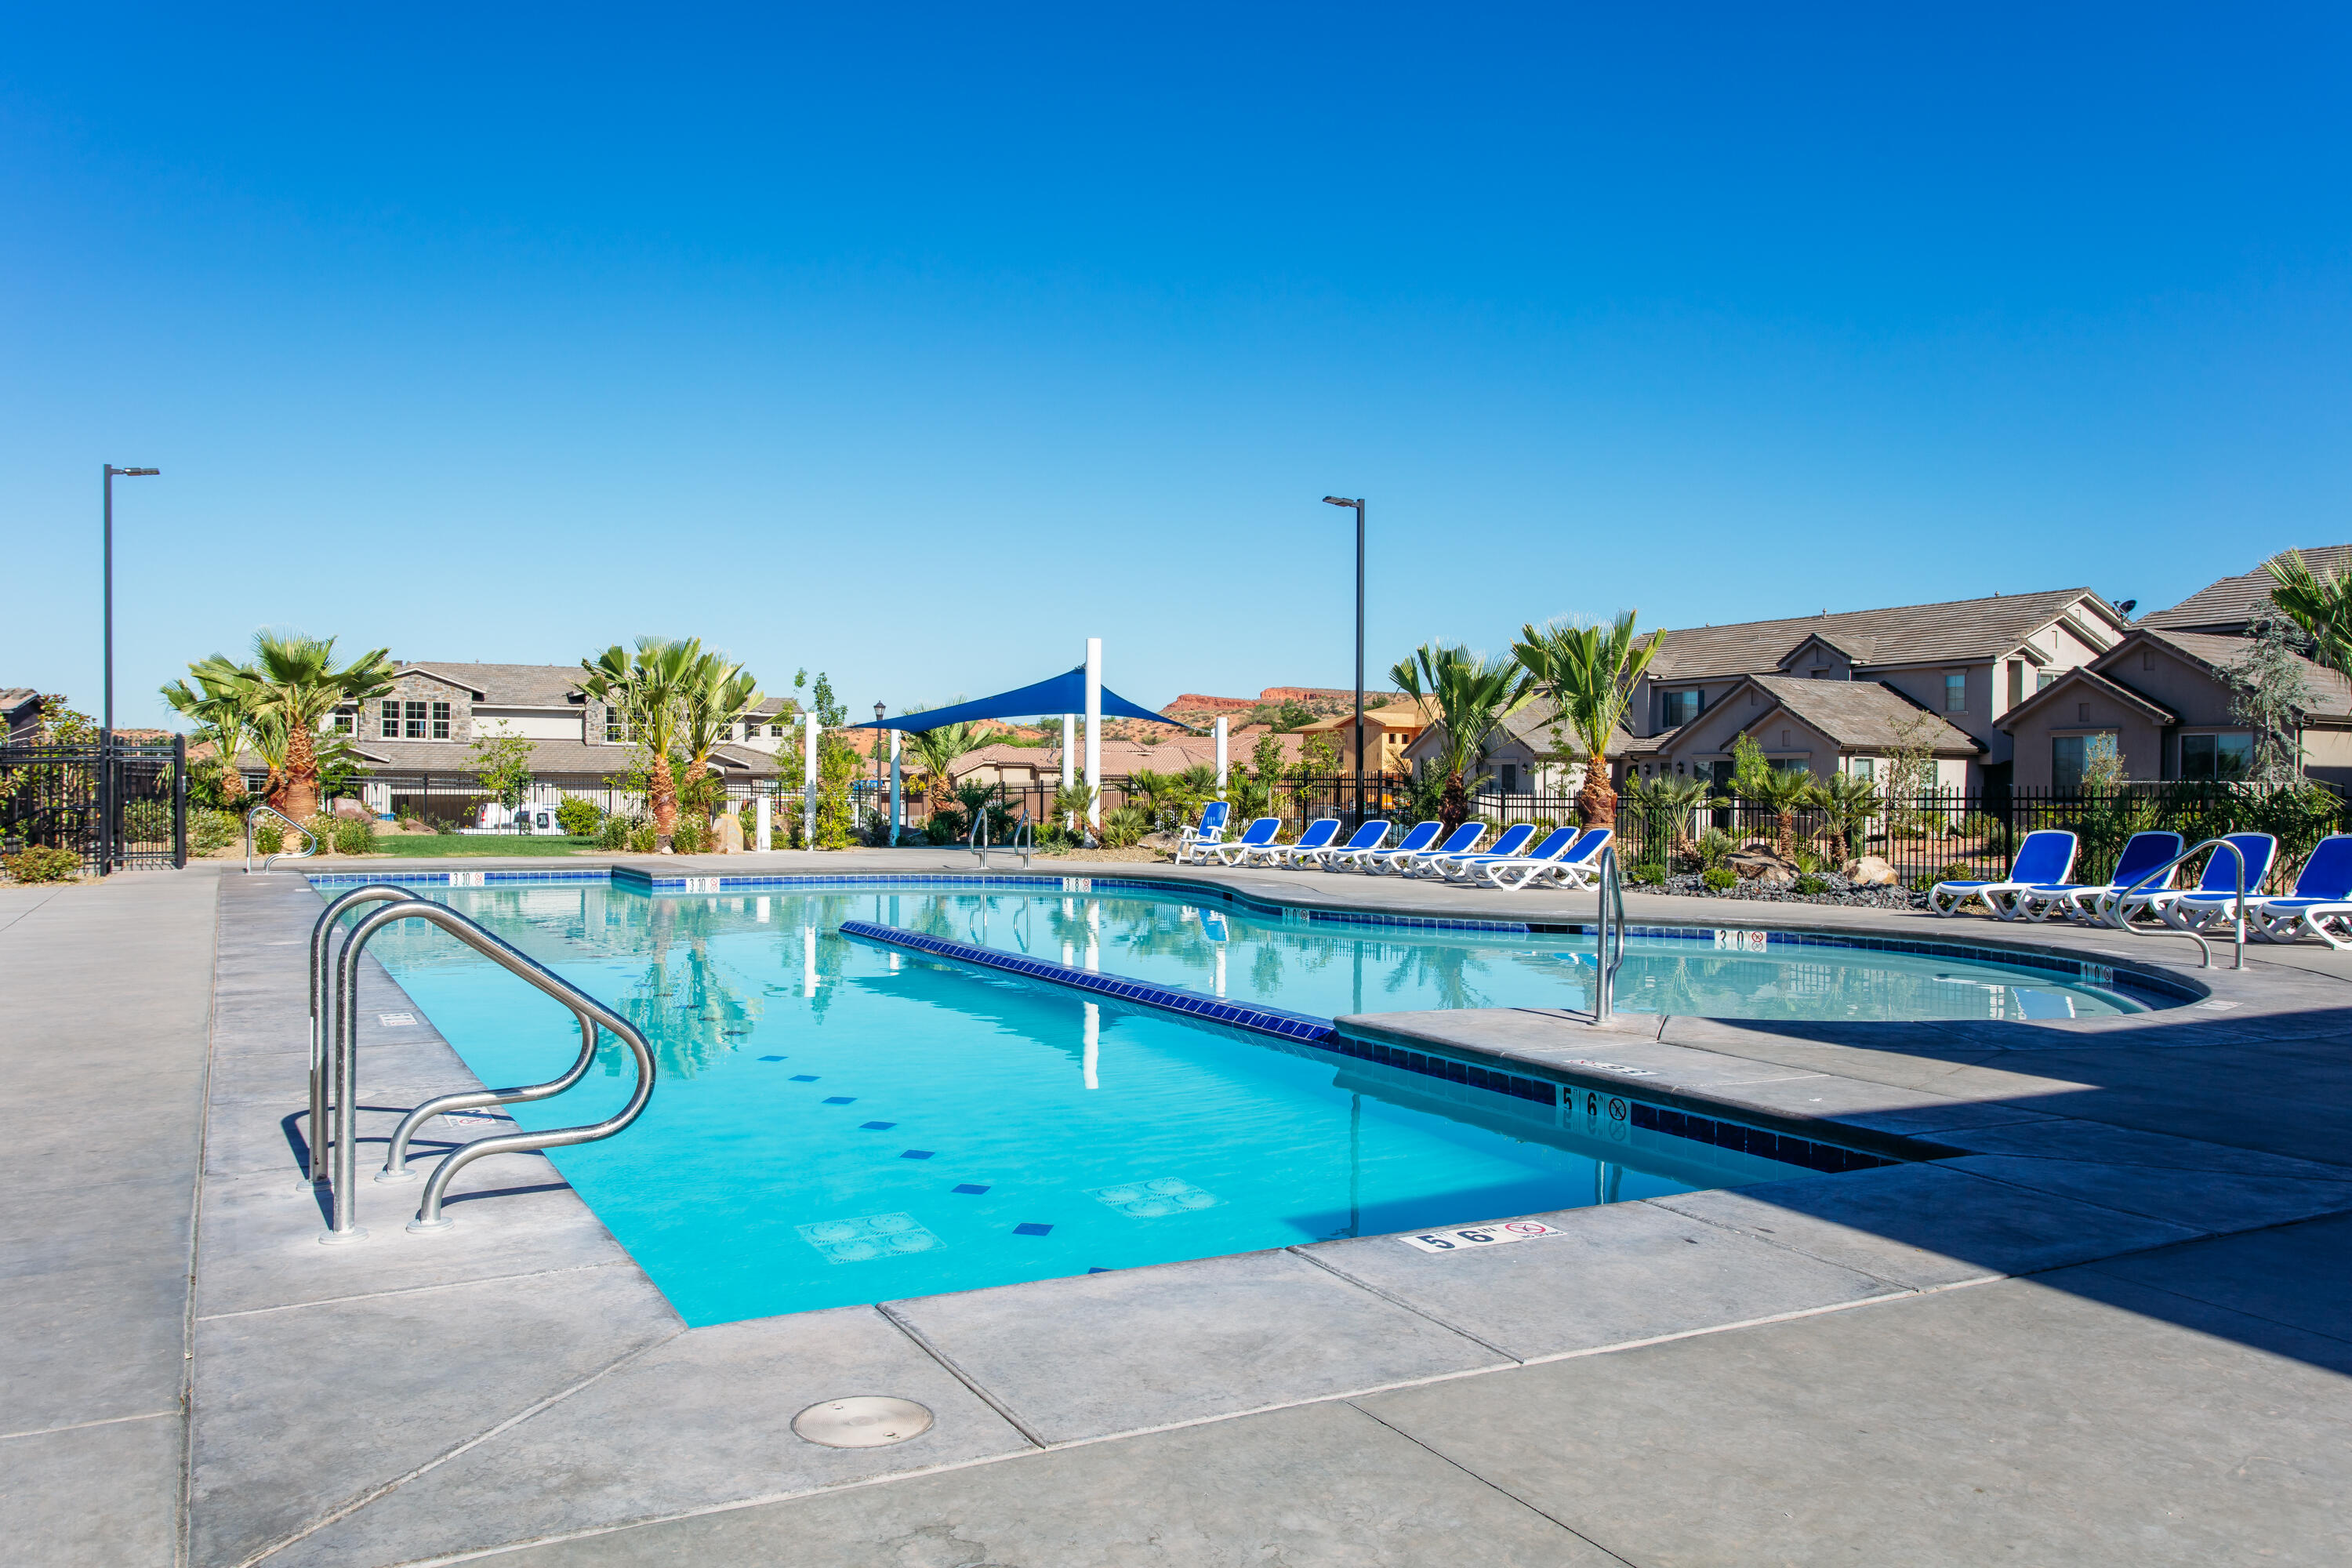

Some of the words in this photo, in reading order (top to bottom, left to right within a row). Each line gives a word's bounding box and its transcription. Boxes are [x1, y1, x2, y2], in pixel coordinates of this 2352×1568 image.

[1563, 1087, 1572, 1110] 5
[1587, 1092, 1597, 1116] 6
[1415, 1235, 1456, 1249] 5
[1457, 1230, 1494, 1243] 6
